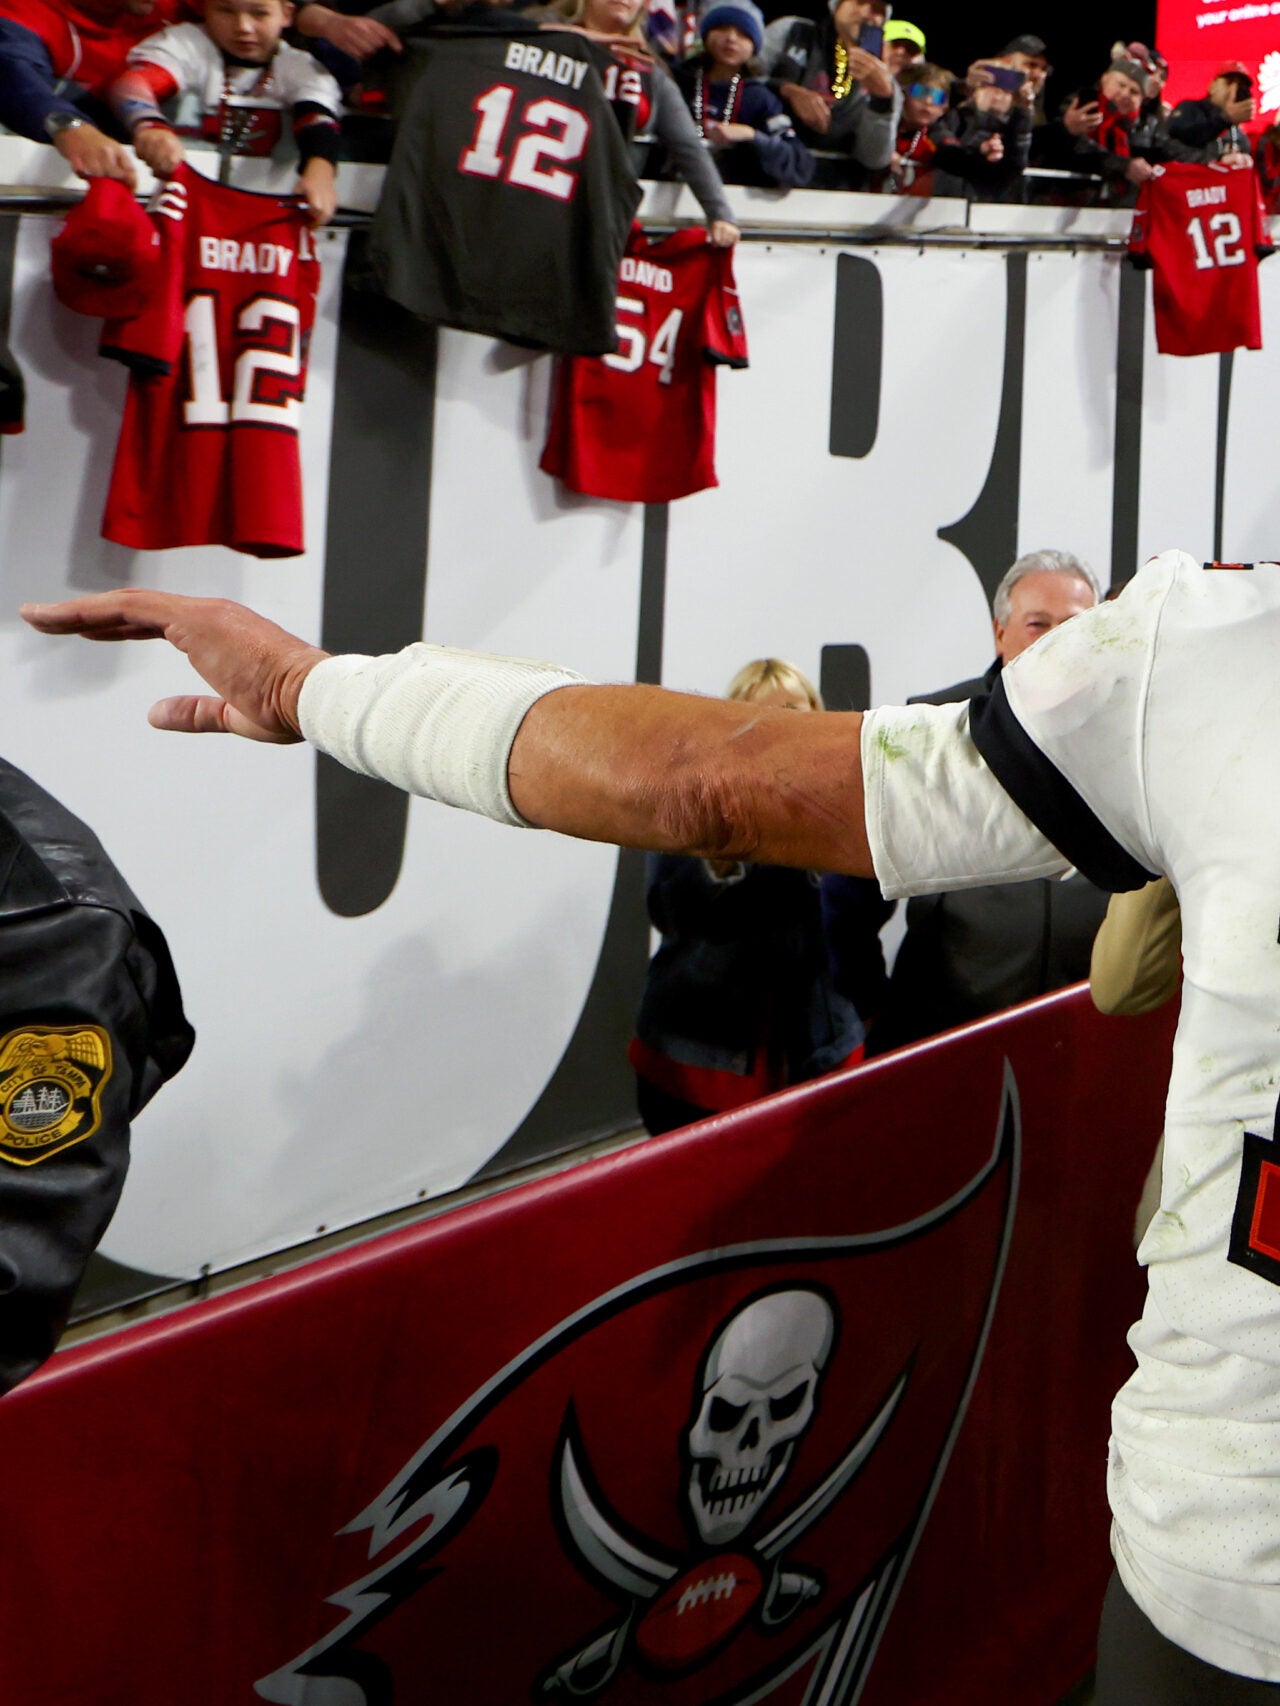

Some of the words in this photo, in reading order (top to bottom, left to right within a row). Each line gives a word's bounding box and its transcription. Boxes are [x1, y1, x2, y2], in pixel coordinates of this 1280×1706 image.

[1228, 4, 1269, 21] online
[504, 41, 588, 90] BRADY
[604, 64, 643, 105] 12
[457, 81, 592, 203] 12
[1185, 185, 1227, 209] BRADY
[199, 235, 294, 278] BRADY
[1186, 212, 1247, 271] 12
[619, 257, 674, 295] DAVID
[181, 289, 304, 434] 12
[602, 296, 684, 385] 54
[1, 1074, 25, 1093] CITY
[32, 1065, 48, 1076] OF
[55, 1065, 87, 1089] TAMPA
[5, 1129, 62, 1147] POLICE
